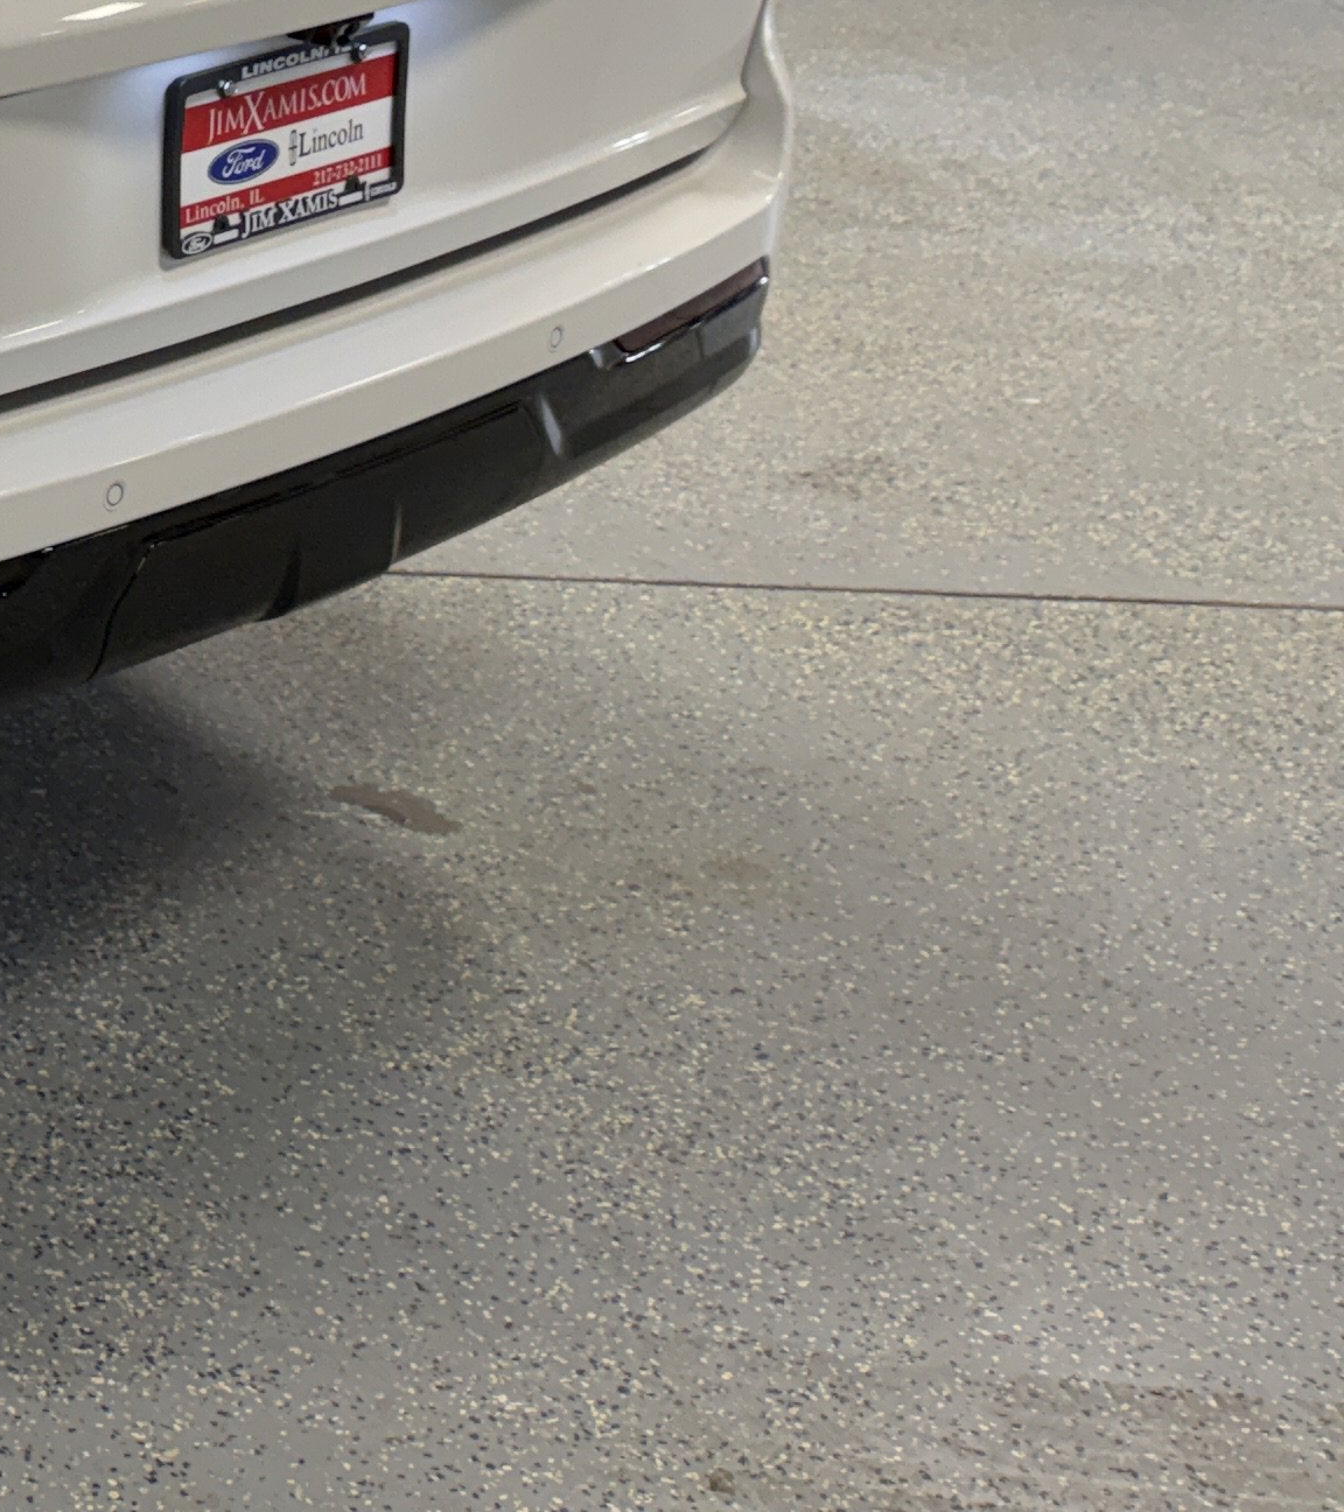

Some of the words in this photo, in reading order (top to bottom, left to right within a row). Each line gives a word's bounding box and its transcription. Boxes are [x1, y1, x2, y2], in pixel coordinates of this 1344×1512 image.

[298, 118, 364, 158] Lincoln
[222, 146, 265, 178] Ford
[241, 209, 278, 239] JIM
[278, 188, 339, 225] XAMIS
[248, 188, 264, 203] IL
